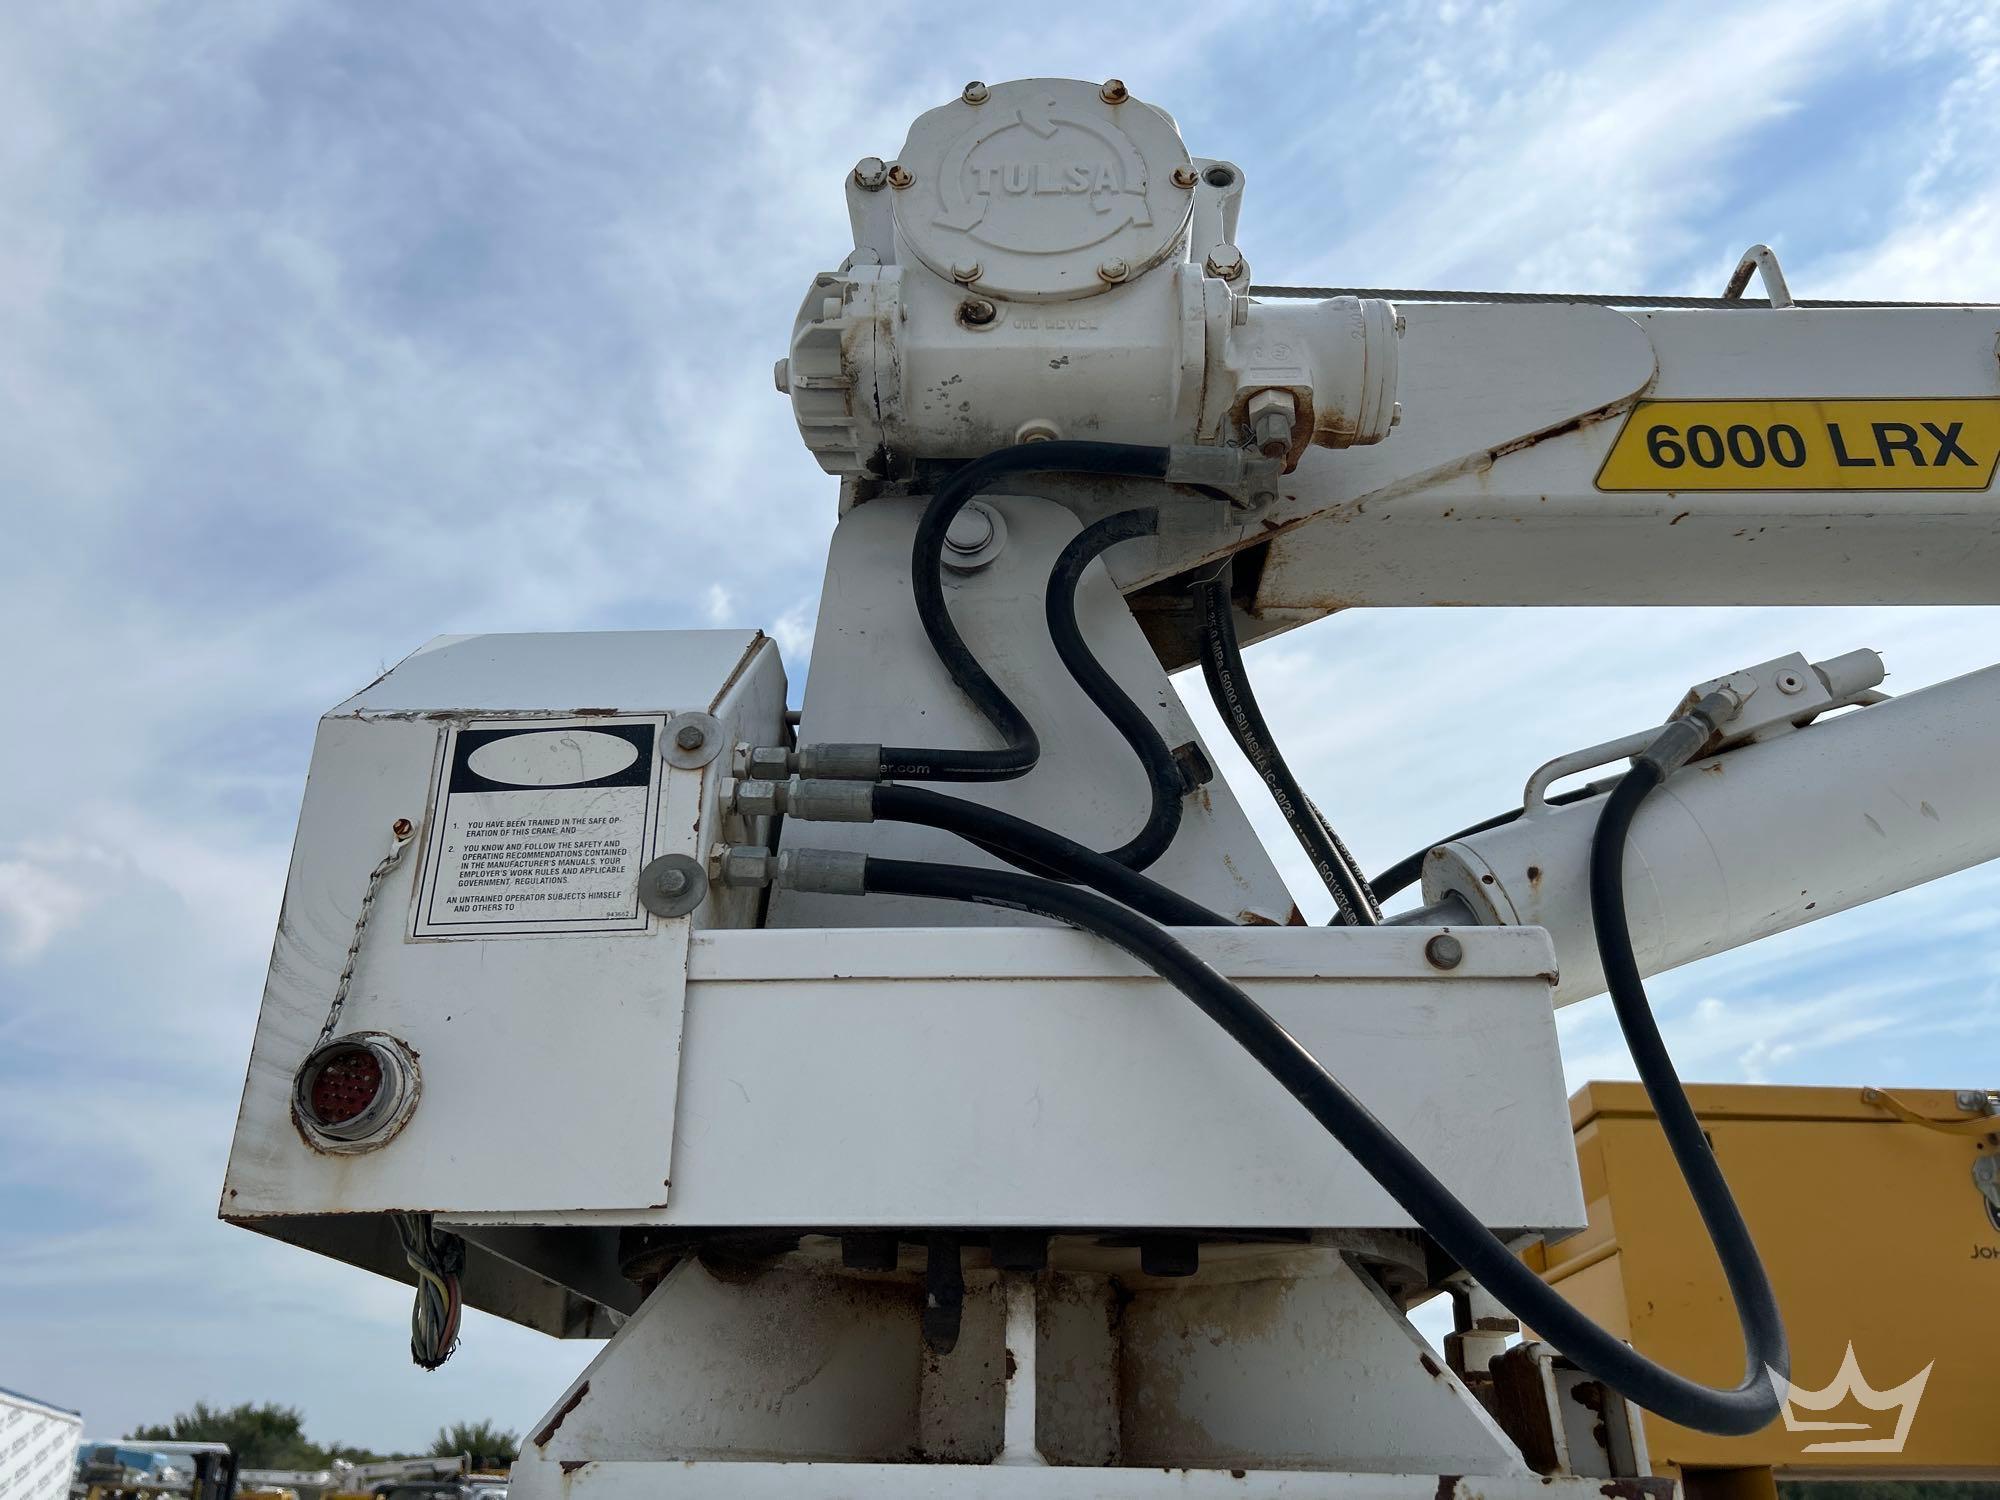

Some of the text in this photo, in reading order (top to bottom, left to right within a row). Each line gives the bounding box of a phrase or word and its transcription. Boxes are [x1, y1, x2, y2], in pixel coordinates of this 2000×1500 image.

[971, 161, 1120, 196] TULSA
[1646, 422, 1979, 469] 6000 LRX
[1210, 639, 1224, 670] MPa
[1220, 669, 1238, 704] (5000
[1232, 704, 1250, 731] PSI)
[1244, 731, 1268, 770] MSHA
[1264, 768, 1296, 819] IC-40/26
[466, 829, 498, 838] ERATION
[462, 848, 628, 861] OPERATING RECOMMENDATIONS CONTAINED
[471, 861, 485, 869] THE
[487, 860, 556, 868] MANUFACTURER'S
[460, 866, 626, 878] EMPLOYER'S WORK RULES AND APPLICABLE
[458, 878, 510, 888] GOVERNMENT
[459, 894, 503, 904] UNTRAINED
[505, 893, 546, 902] OPERATOR
[548, 892, 586, 900] SUBJECTS
[588, 891, 622, 900] HIMSELF
[472, 904, 503, 912] OTHERS
